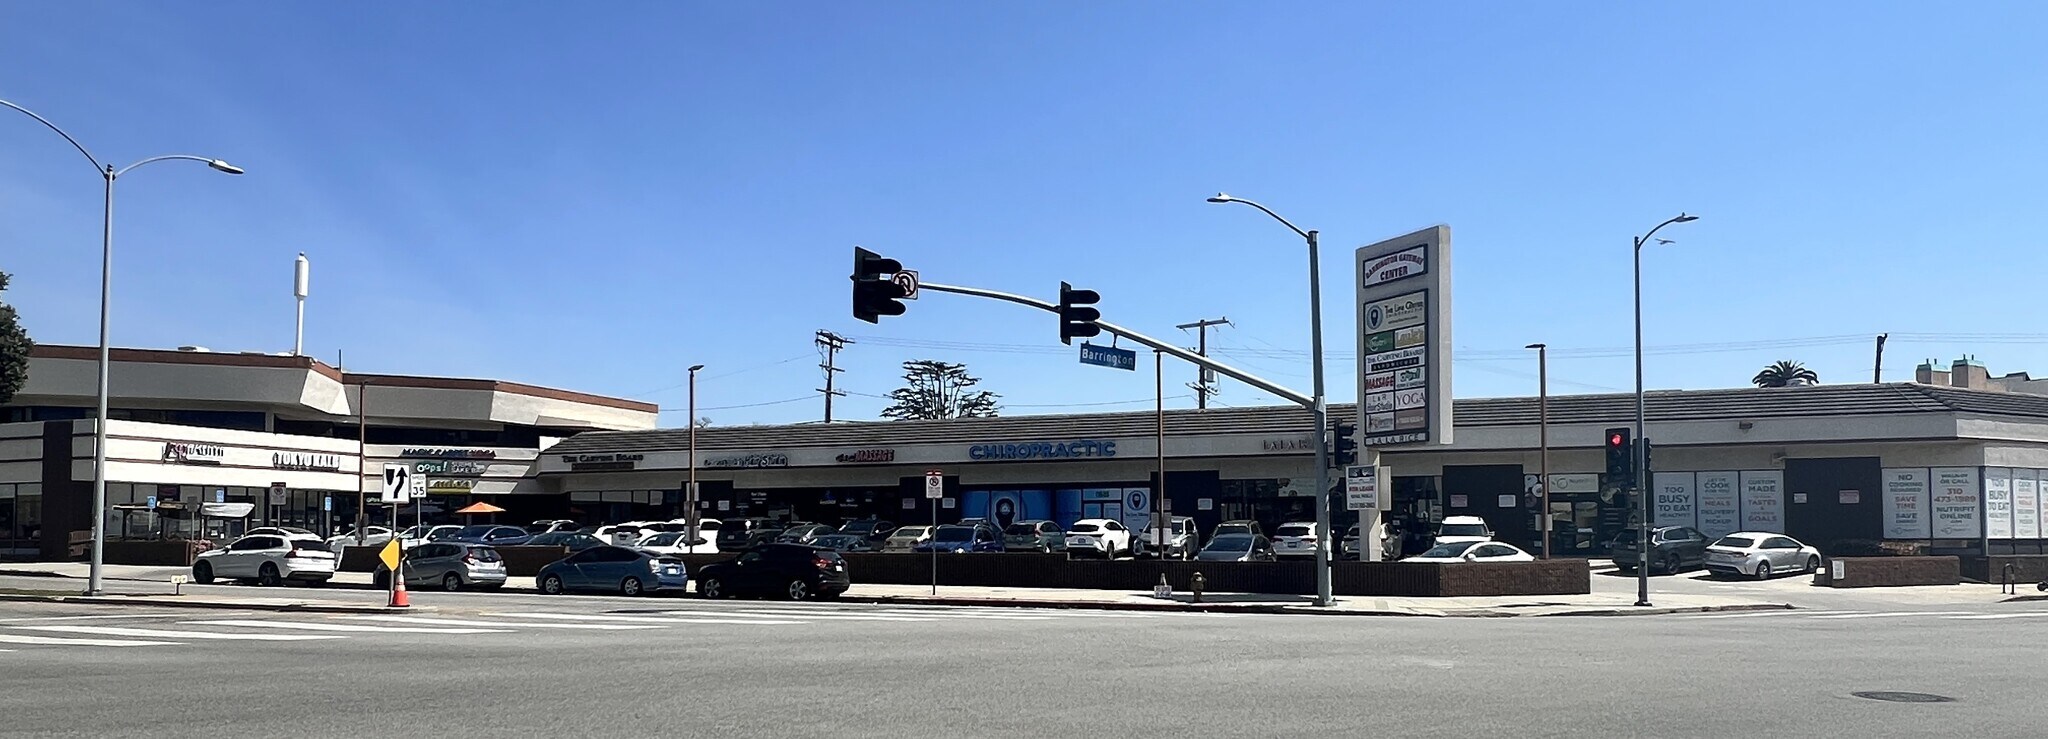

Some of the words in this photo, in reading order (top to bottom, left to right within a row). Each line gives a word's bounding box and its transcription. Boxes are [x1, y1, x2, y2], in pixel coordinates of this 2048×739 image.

[1380, 265, 1408, 281] CENTER
[1083, 348, 1133, 366] Barrington
[1396, 392, 1425, 406] YOGA
[969, 440, 1116, 460] CHIROPRACTIC
[1664, 486, 1685, 494] TOO
[1704, 482, 1730, 490] COOK
[1748, 485, 1776, 493] MADE
[413, 486, 425, 496] 35
[1947, 487, 1964, 496] 310
[1988, 490, 2009, 501] BUSY
[1658, 494, 1691, 505] BUSY
[1748, 499, 1777, 507] TASTES
[1658, 504, 1671, 512] TO
[1673, 504, 1692, 512] EAT
[1896, 502, 1916, 510] TIME
[1988, 502, 1997, 511] TO
[1701, 508, 1736, 516] DELIVERY
[1940, 512, 1973, 521] ONLINE
[1748, 515, 1777, 523] GOALS
